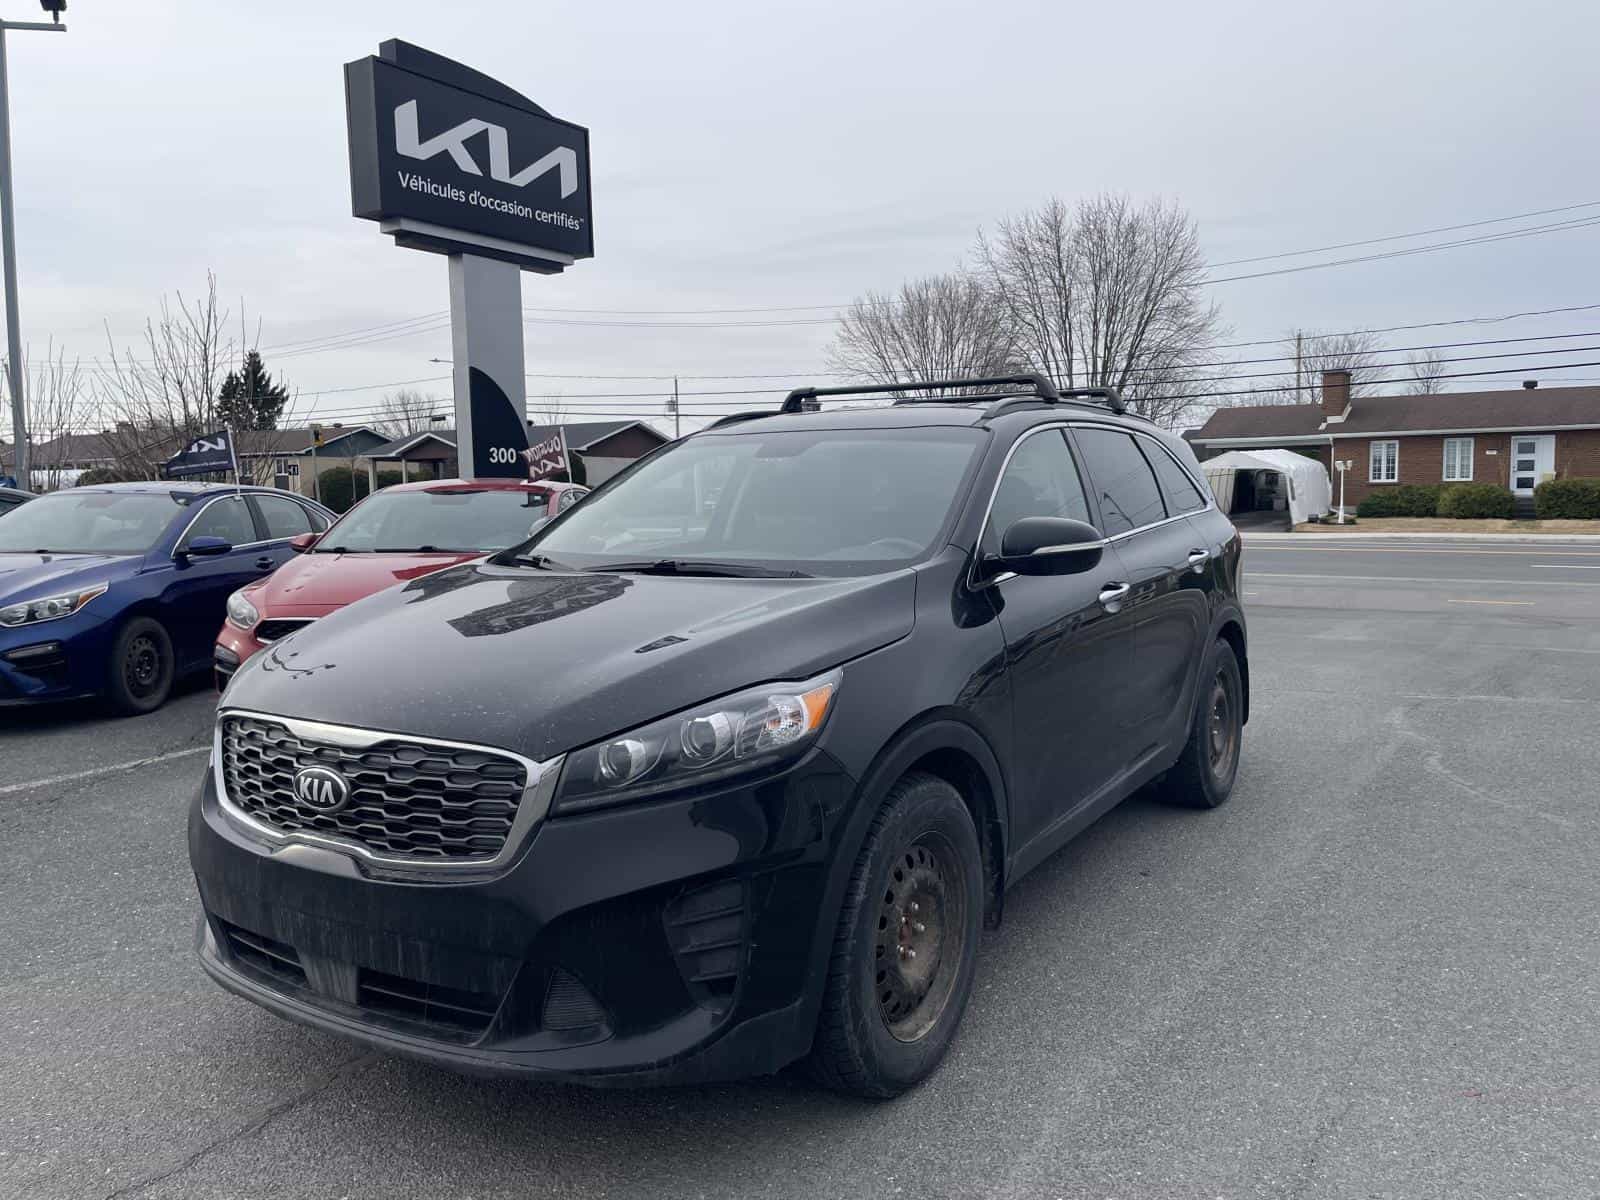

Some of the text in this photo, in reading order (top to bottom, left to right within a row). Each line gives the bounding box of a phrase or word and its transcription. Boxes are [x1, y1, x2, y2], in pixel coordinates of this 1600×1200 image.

[394, 99, 578, 200] KIA
[398, 170, 580, 231] Véhicules d'occasion certifiés
[489, 447, 517, 463] 300
[300, 775, 336, 804] KIA
